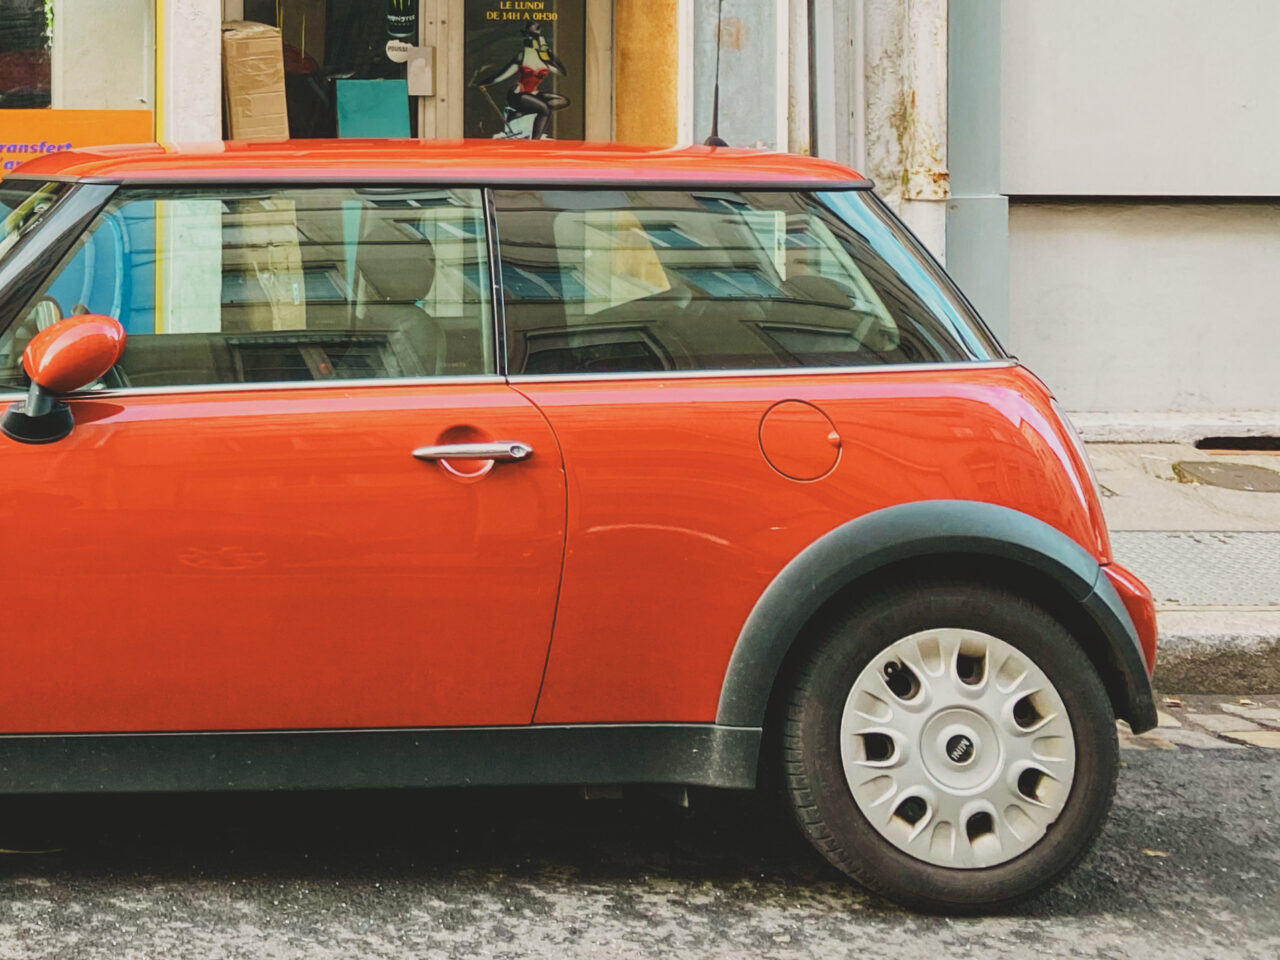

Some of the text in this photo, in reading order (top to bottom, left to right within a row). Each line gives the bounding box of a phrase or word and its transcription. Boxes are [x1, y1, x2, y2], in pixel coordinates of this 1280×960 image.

[500, 1, 545, 10] LE LUNDI
[486, 11, 558, 21] DE 14H A 0H30
[950, 737, 970, 761] MINI
